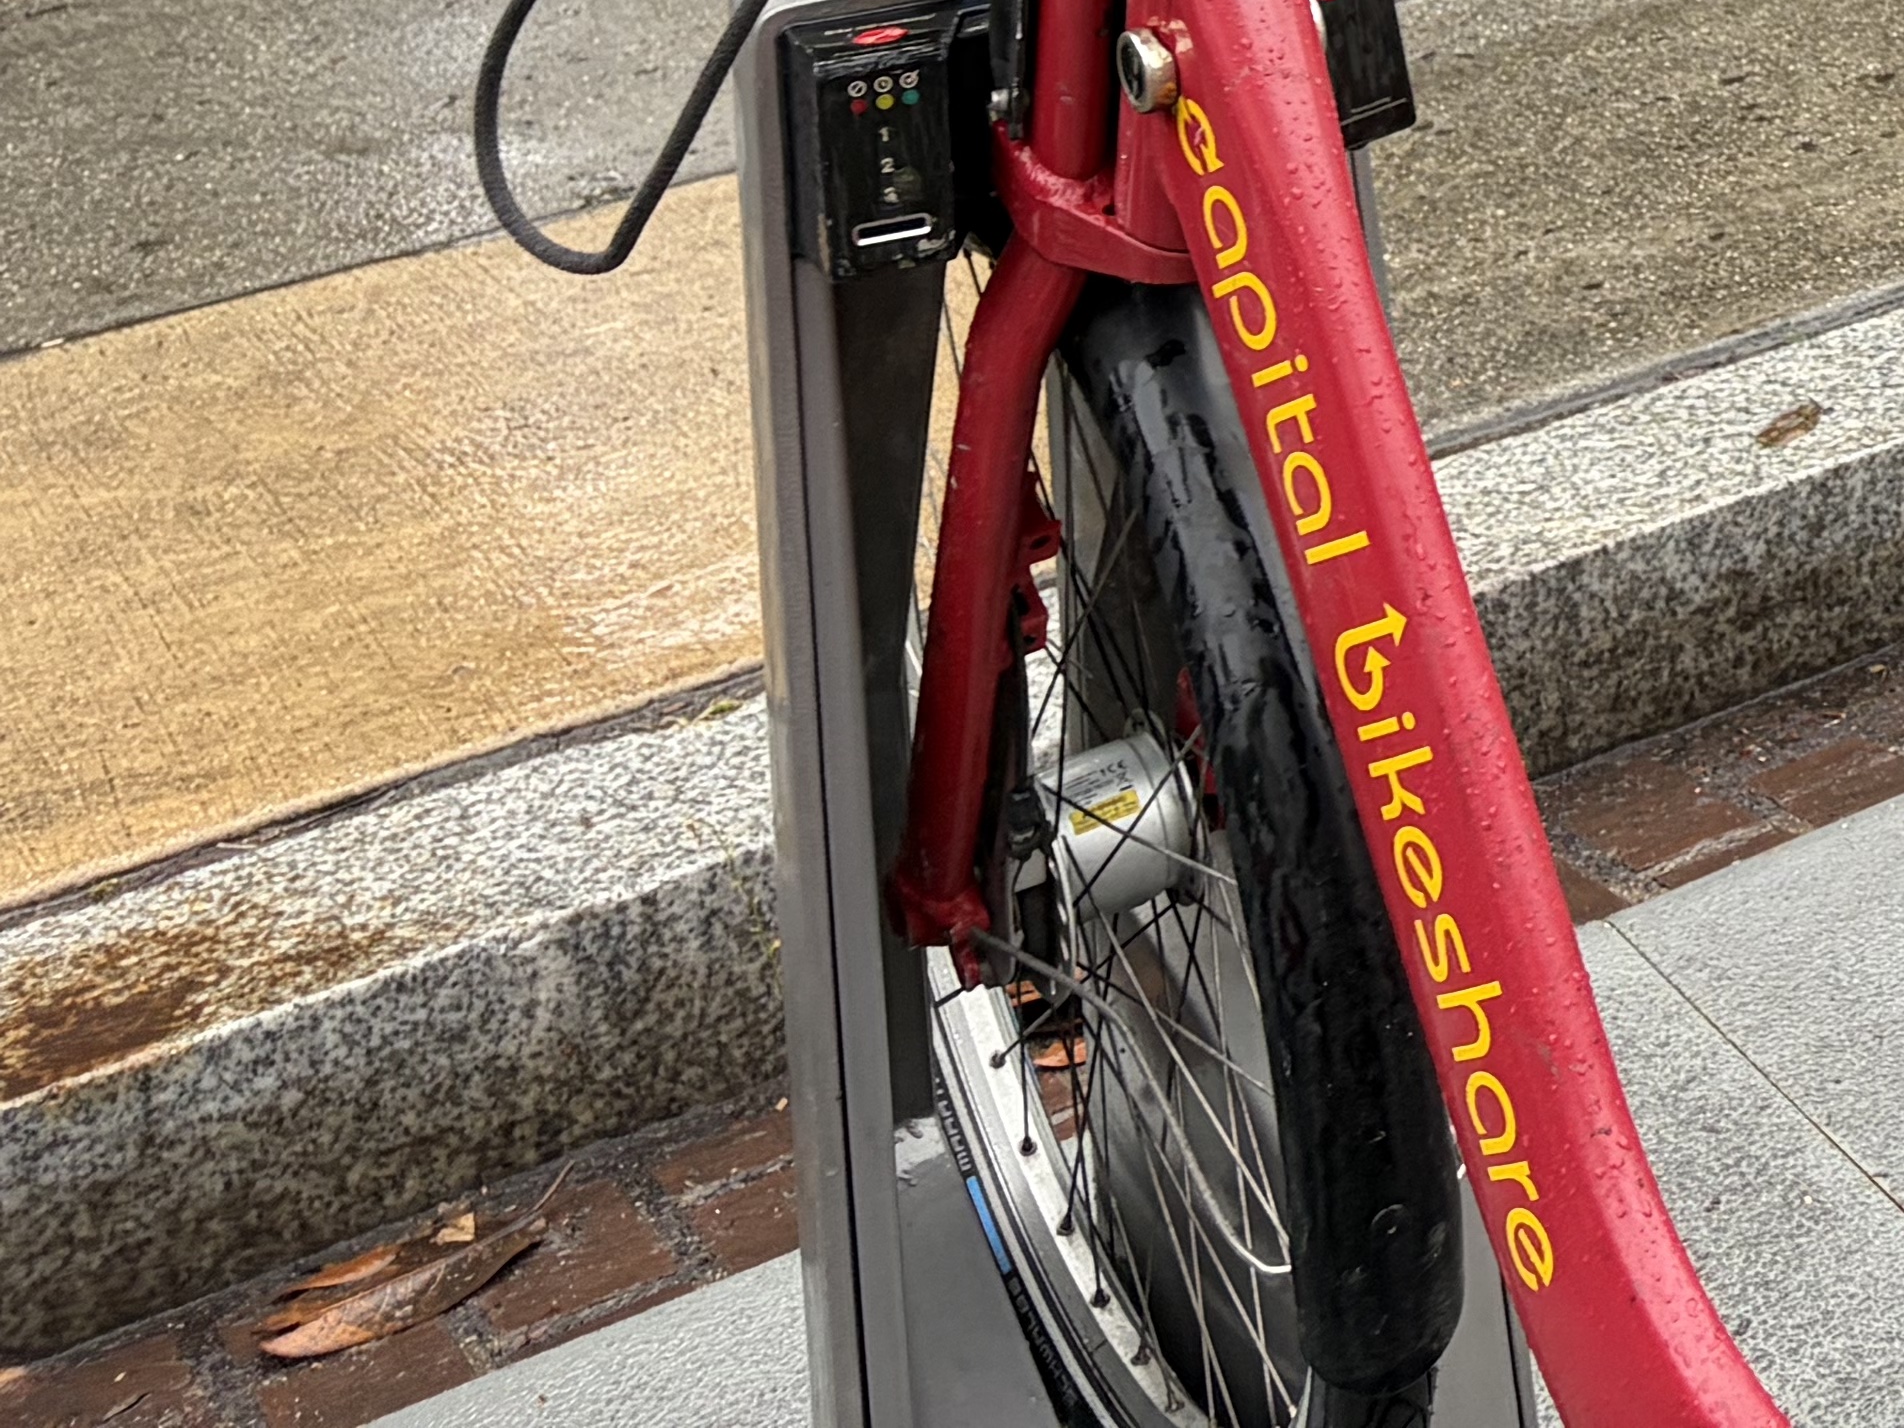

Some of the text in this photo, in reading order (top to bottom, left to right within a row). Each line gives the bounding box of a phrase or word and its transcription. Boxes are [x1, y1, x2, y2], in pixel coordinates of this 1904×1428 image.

[878, 126, 891, 142] 1
[880, 157, 895, 174] 2
[1175, 98, 1370, 566] capital
[1333, 603, 1556, 1294] bikeshare
